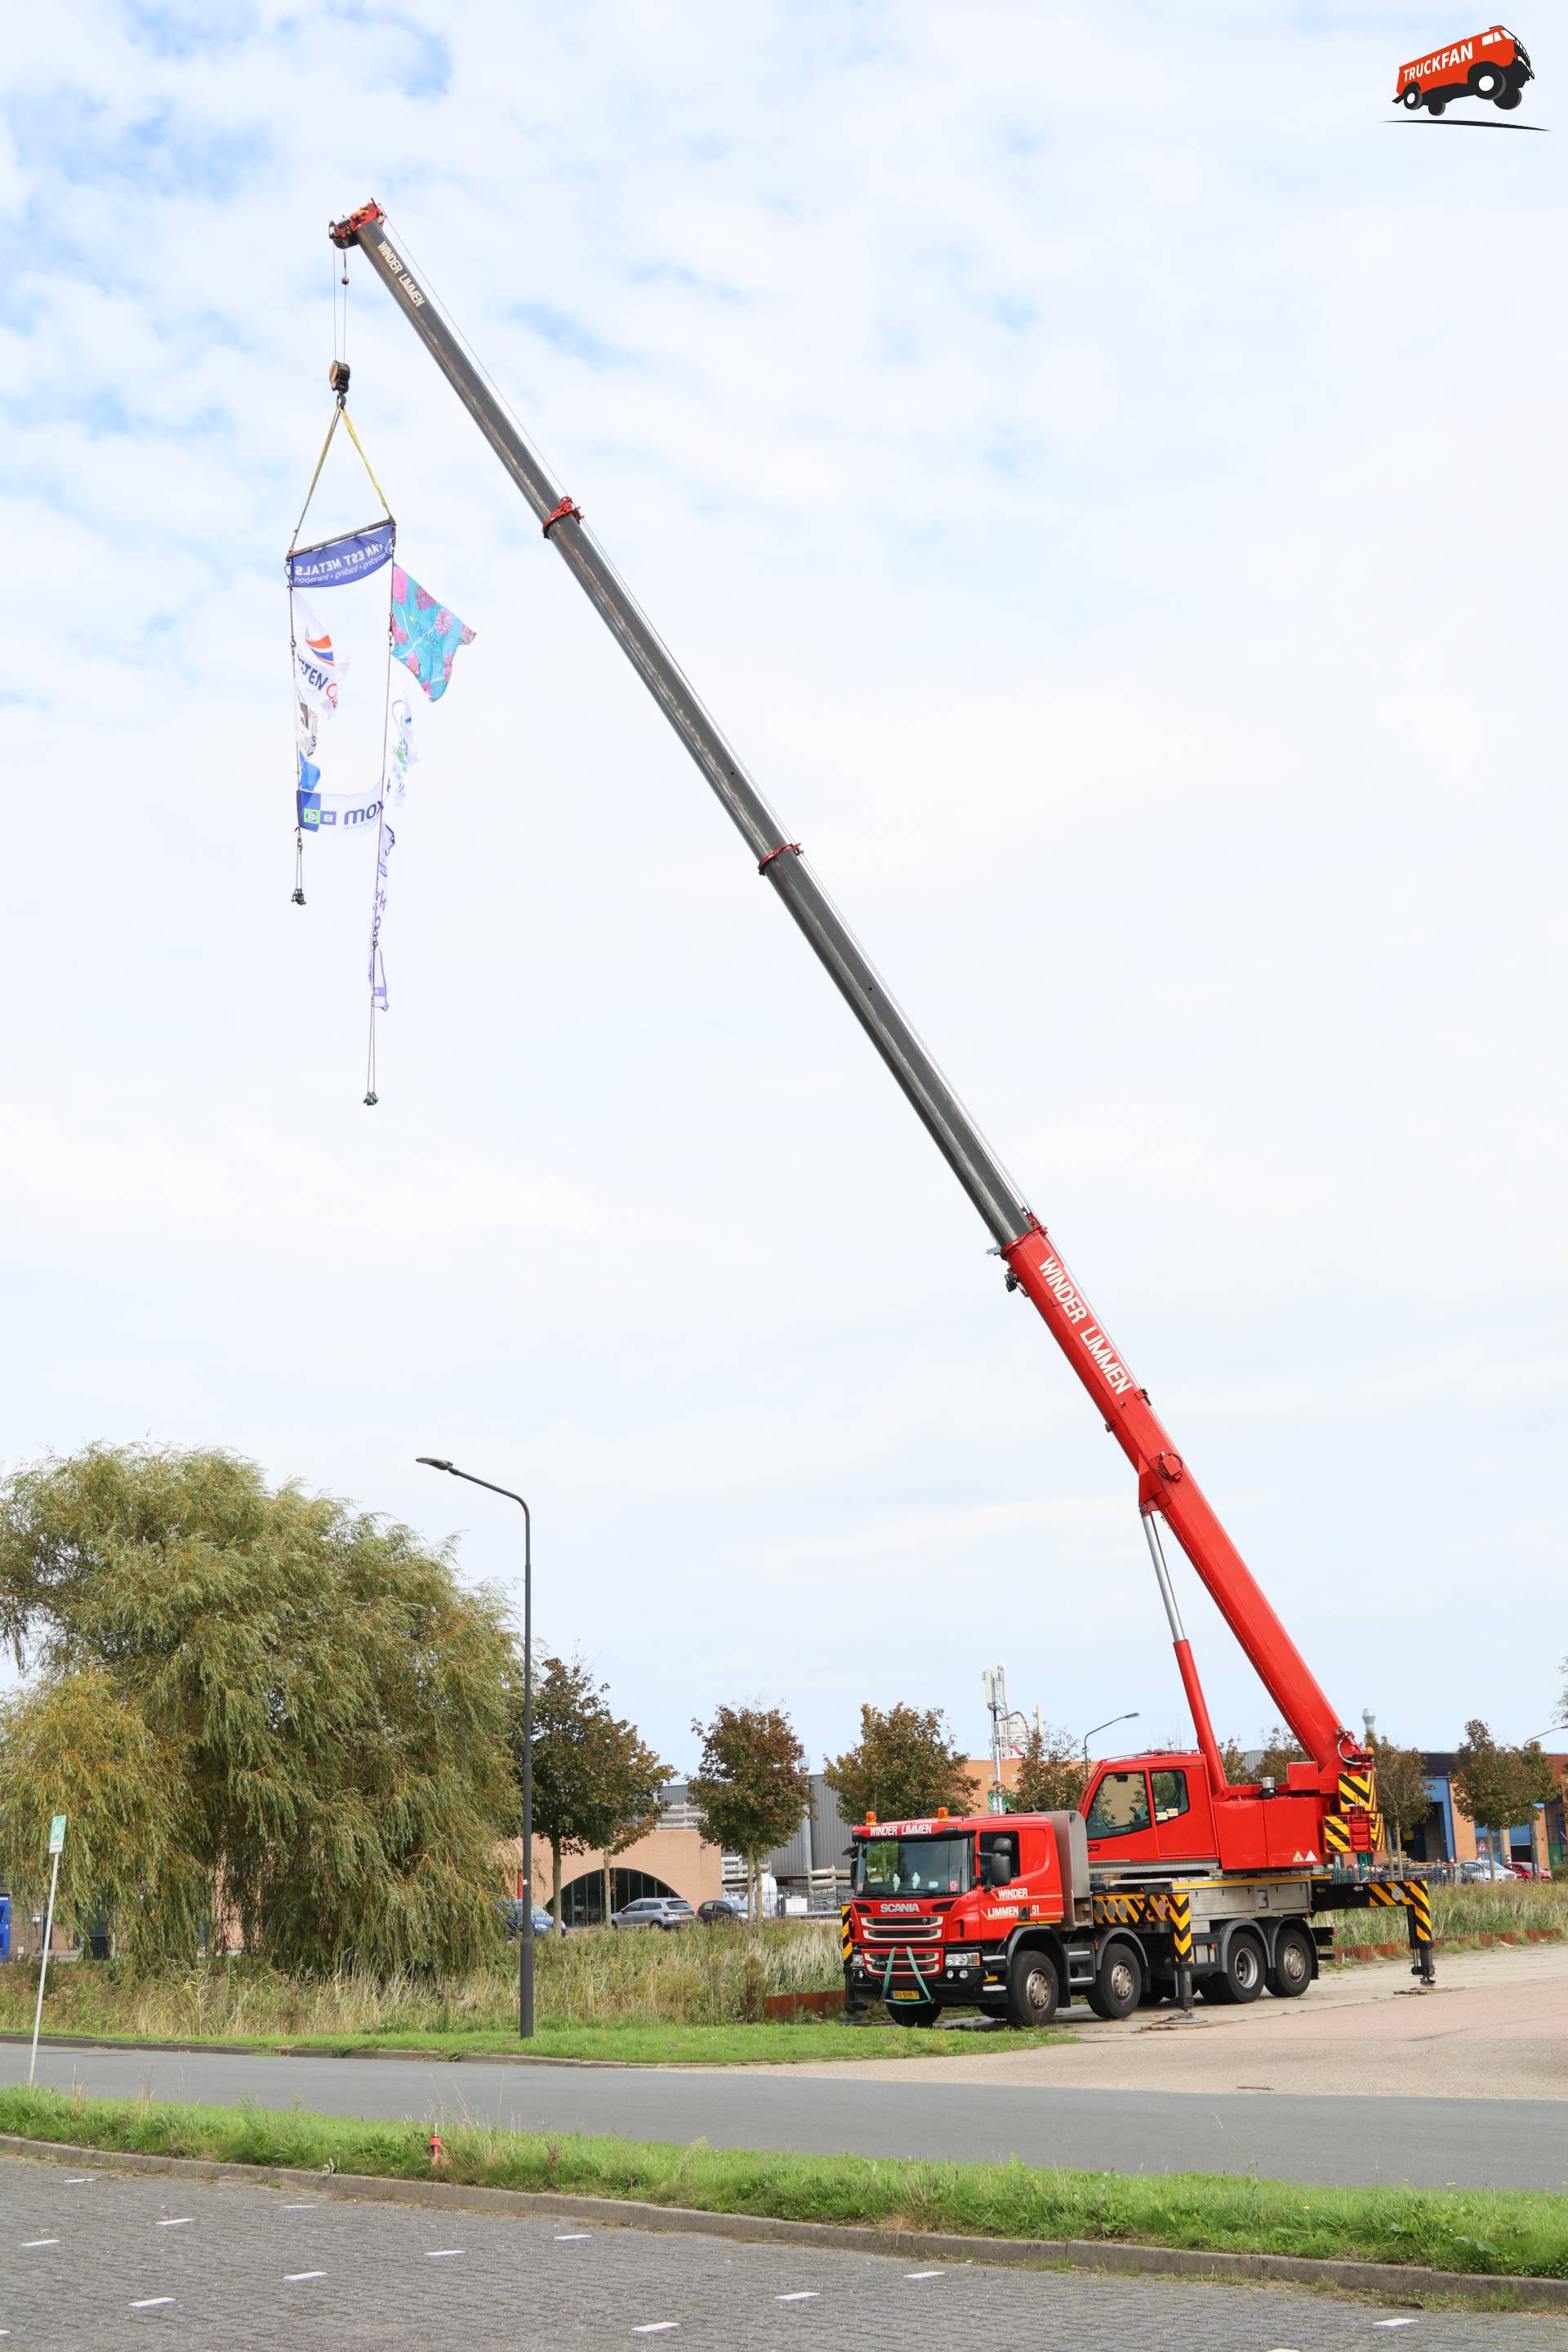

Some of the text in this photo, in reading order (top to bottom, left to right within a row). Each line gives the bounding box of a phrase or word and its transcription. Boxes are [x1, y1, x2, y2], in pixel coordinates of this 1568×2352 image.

[377, 241, 425, 307] WINDER LIMMEN
[1038, 1255, 1133, 1395] WINDER LIMMEN
[870, 1824, 932, 1837] WINDER LIMMEN
[997, 1887, 1028, 1899] WINDER
[880, 1903, 920, 1913] SCANIA
[987, 1904, 1040, 1918] LIMMEN 51
